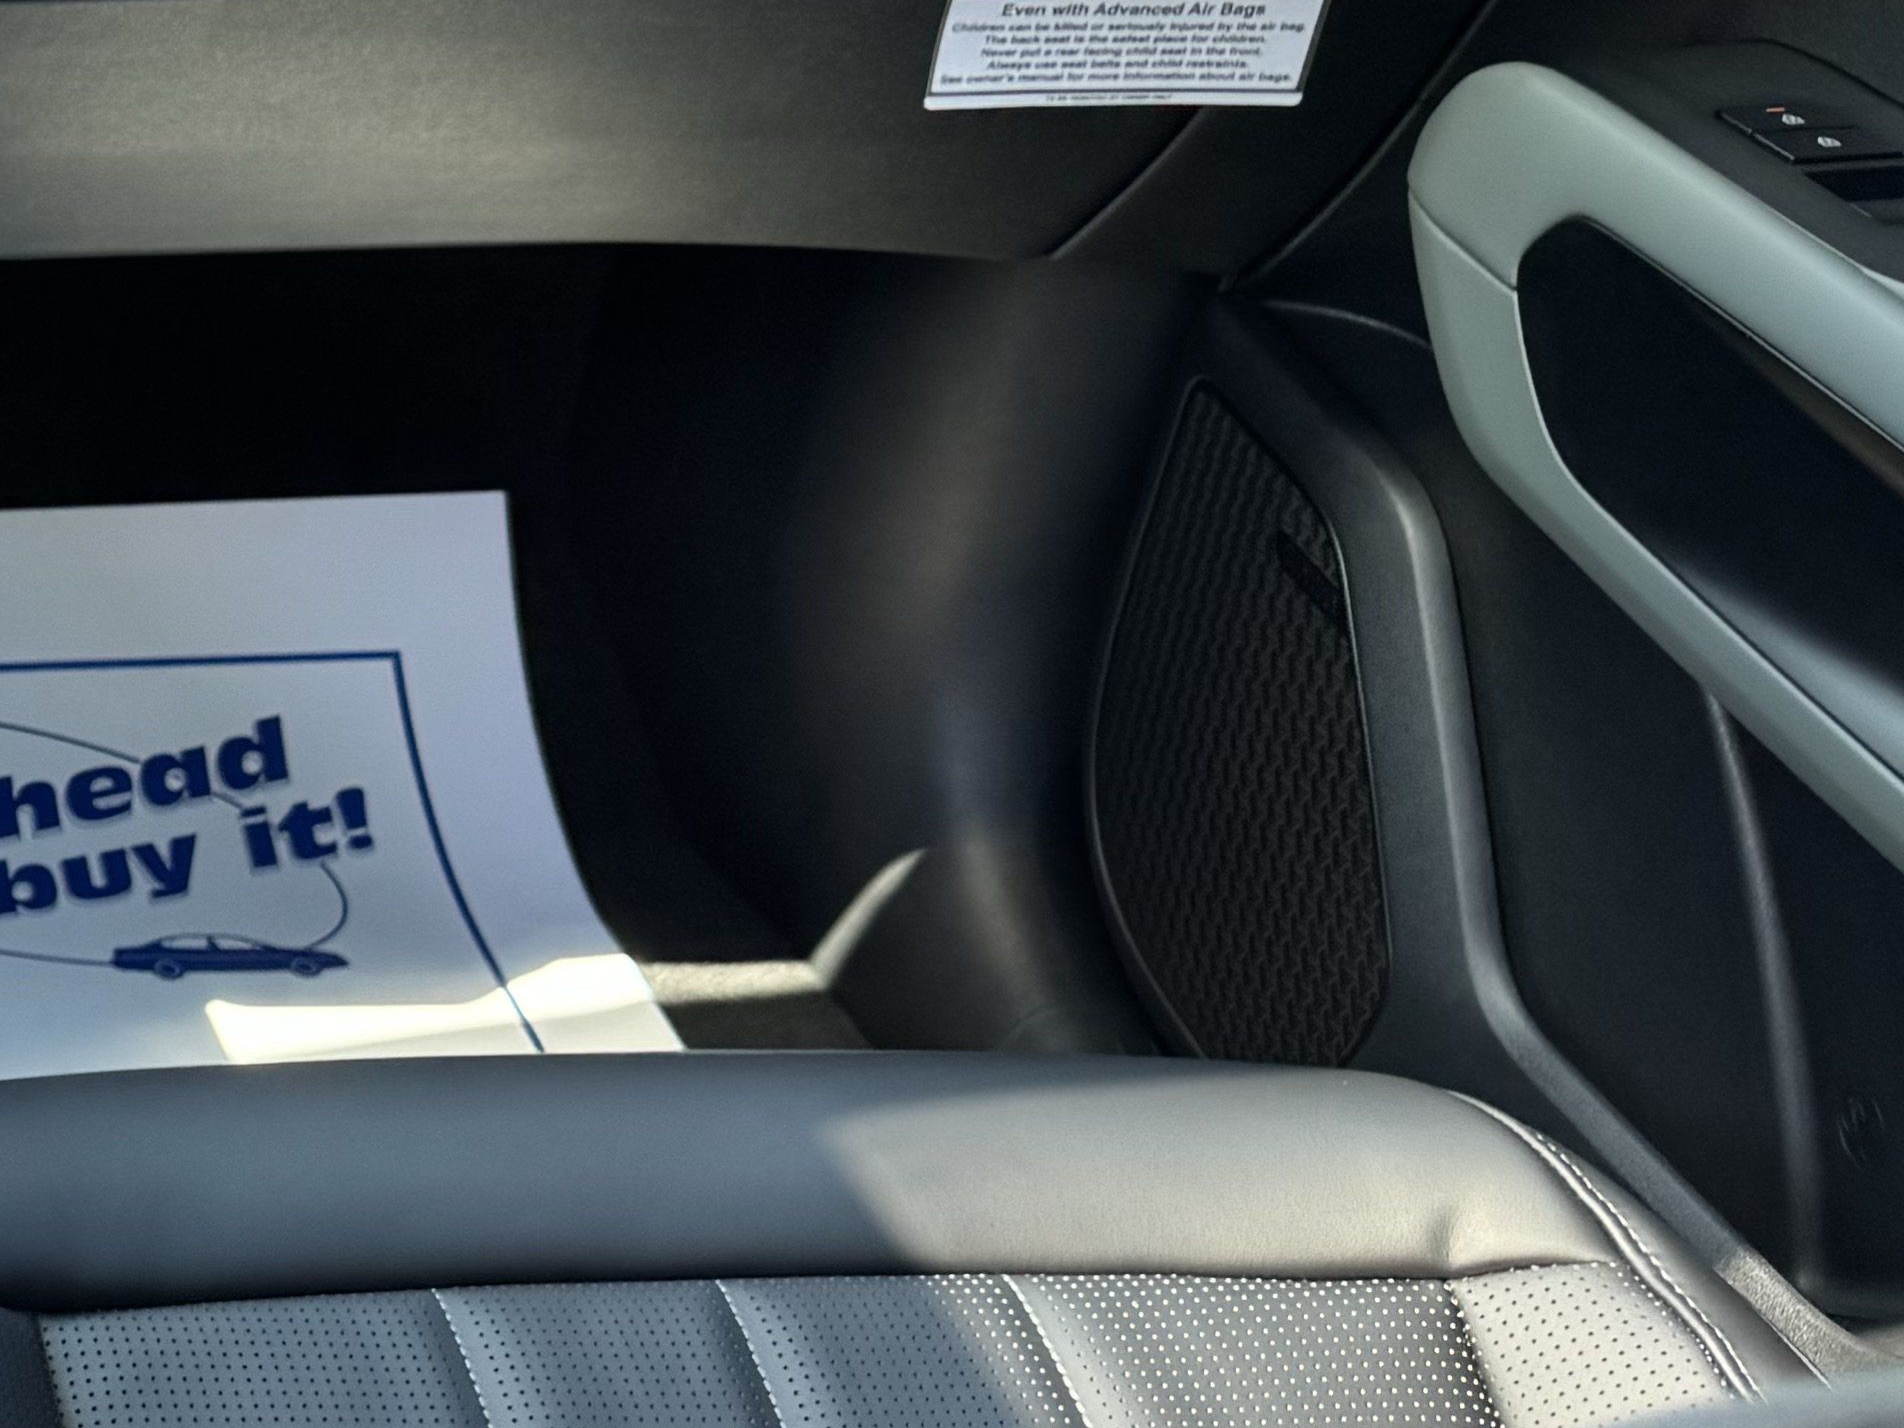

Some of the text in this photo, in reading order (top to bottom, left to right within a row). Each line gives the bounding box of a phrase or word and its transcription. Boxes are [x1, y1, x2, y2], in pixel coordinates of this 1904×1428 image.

[1001, 1, 1266, 19] Even with Advanced Air Bags
[240, 786, 376, 872] it!
